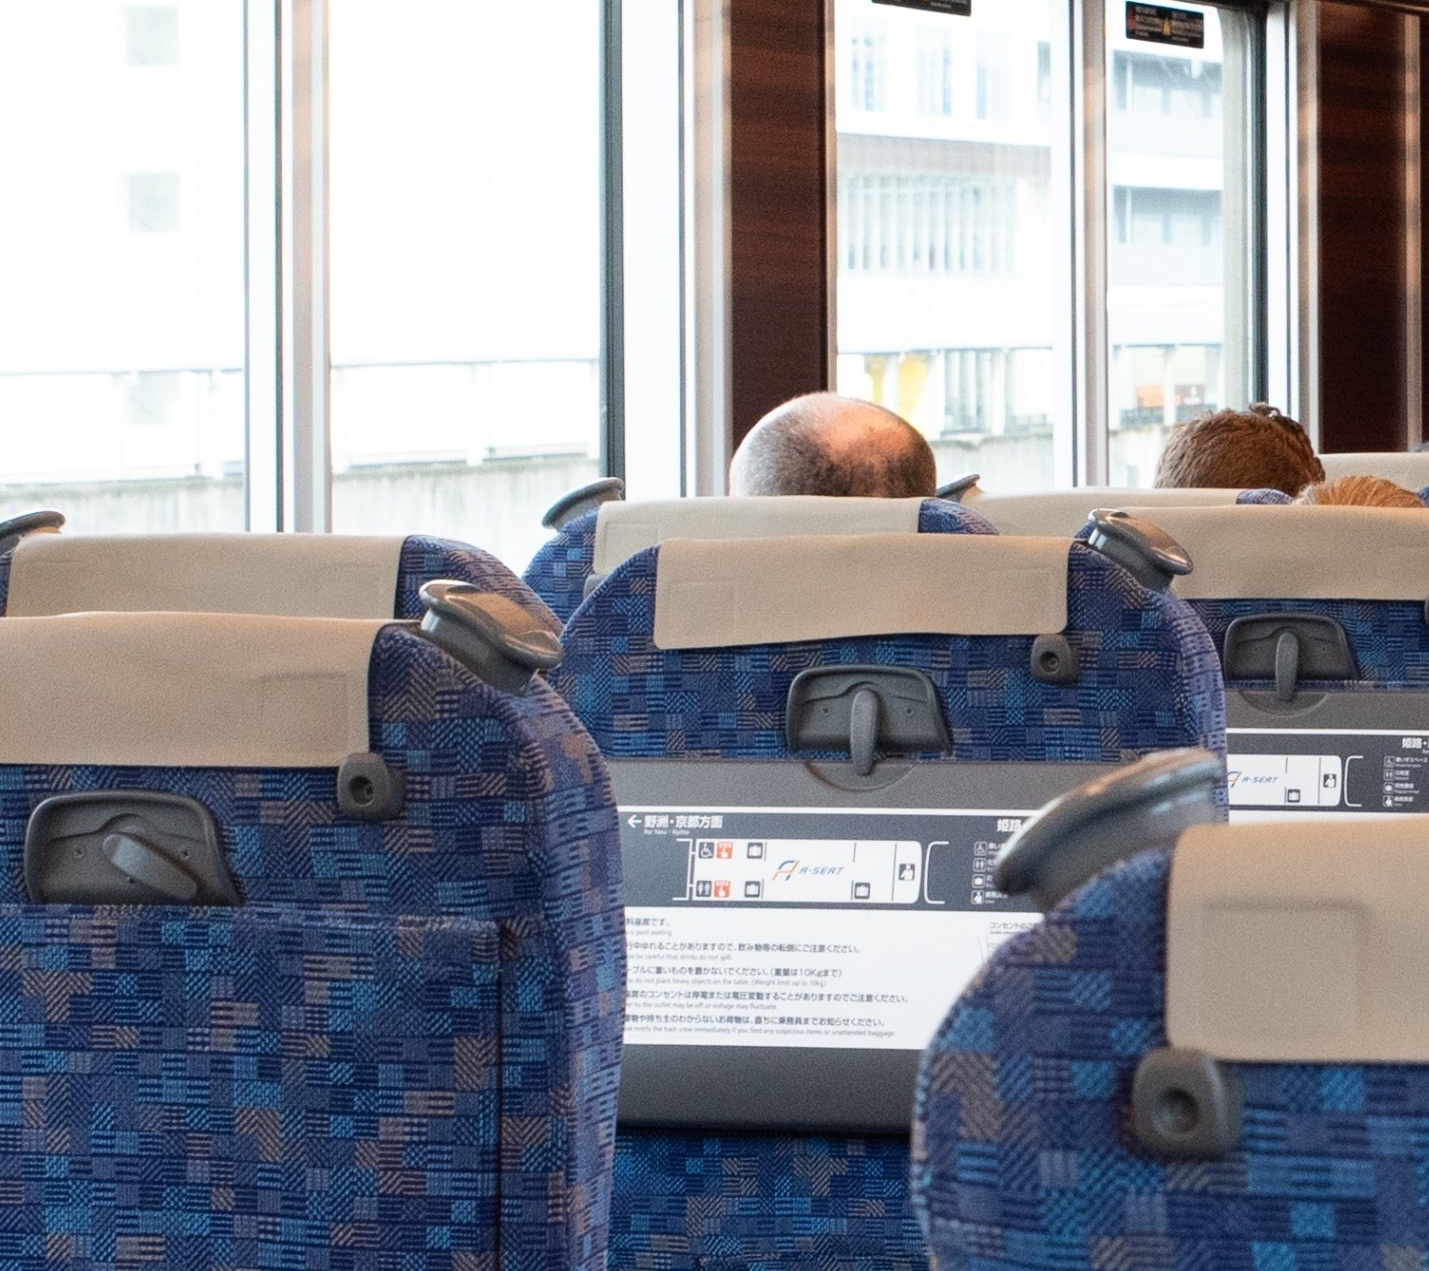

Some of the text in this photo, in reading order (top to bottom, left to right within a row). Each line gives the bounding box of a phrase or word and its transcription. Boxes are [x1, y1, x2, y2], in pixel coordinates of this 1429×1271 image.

[1241, 776, 1278, 784] A-SEAT
[644, 814, 723, 829] 野洲・京都方面
[799, 866, 844, 876] A-SEAT
